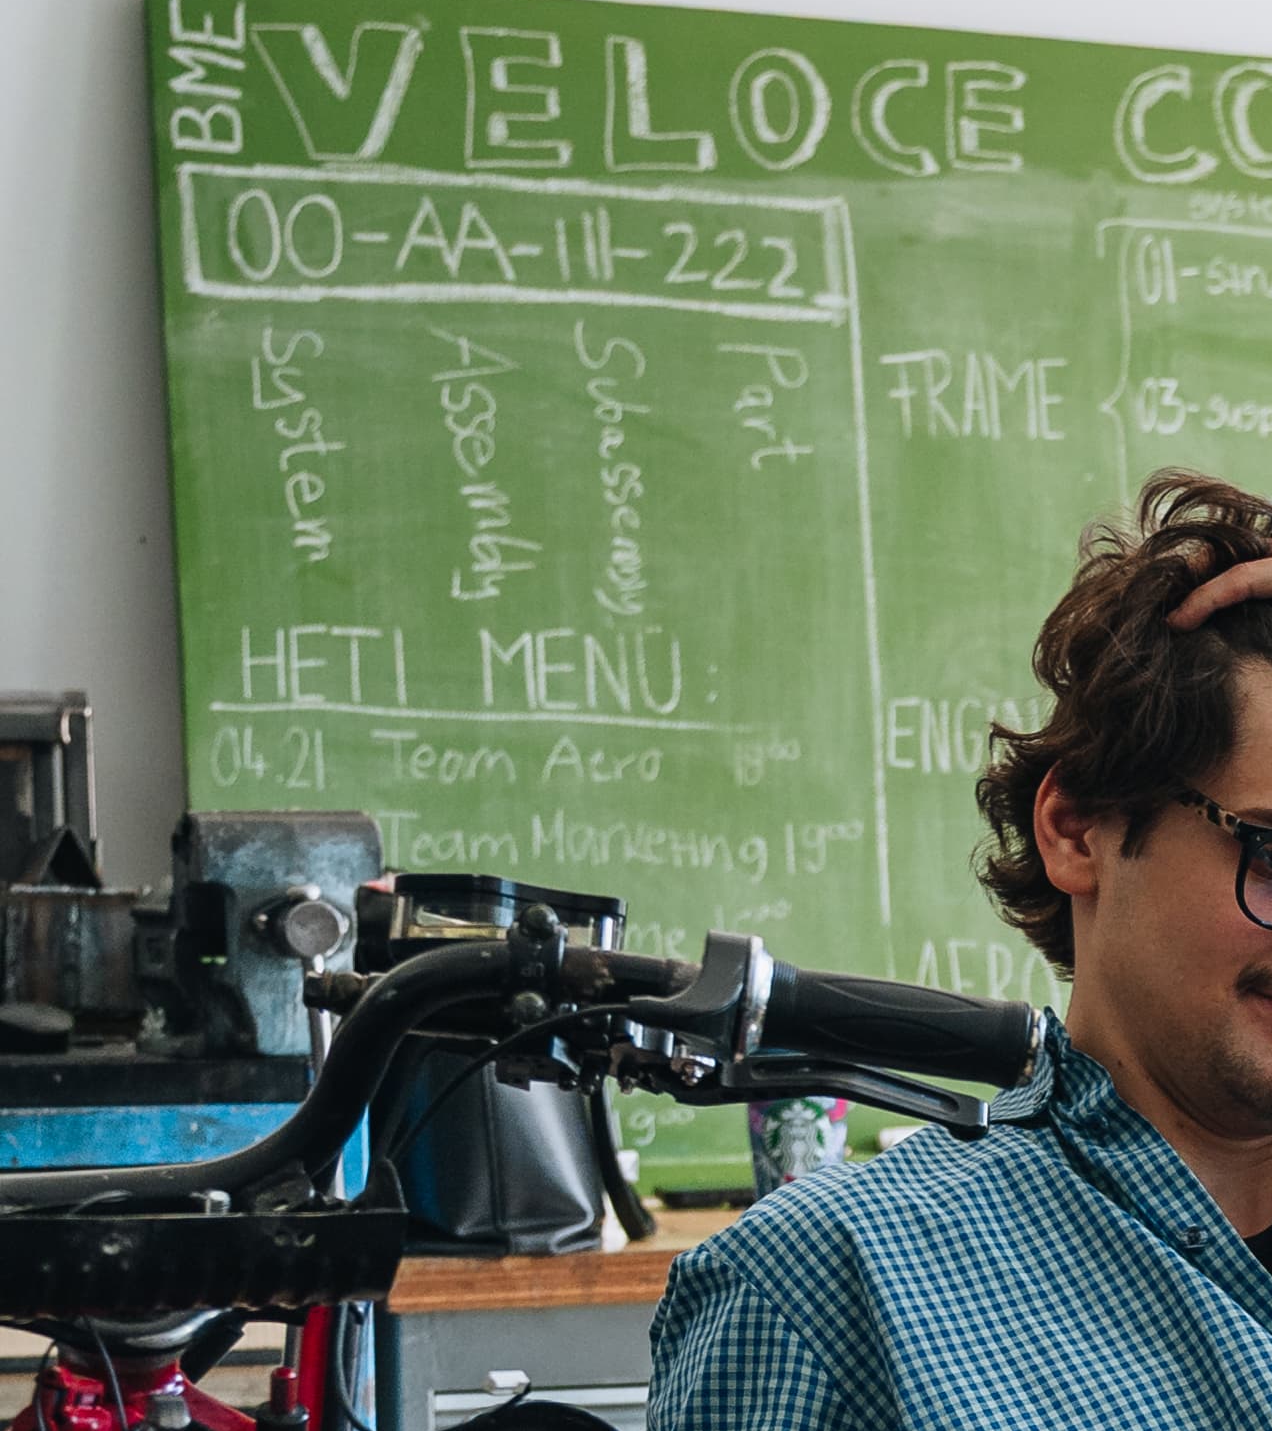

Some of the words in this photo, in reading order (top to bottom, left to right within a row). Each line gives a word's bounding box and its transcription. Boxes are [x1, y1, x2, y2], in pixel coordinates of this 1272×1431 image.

[250, 15, 1027, 177] VELOCE
[250, 325, 346, 563] System
[422, 321, 544, 602] Assembly
[717, 343, 814, 471] Part
[880, 349, 1069, 442] FRAME
[241, 623, 408, 705] HETI
